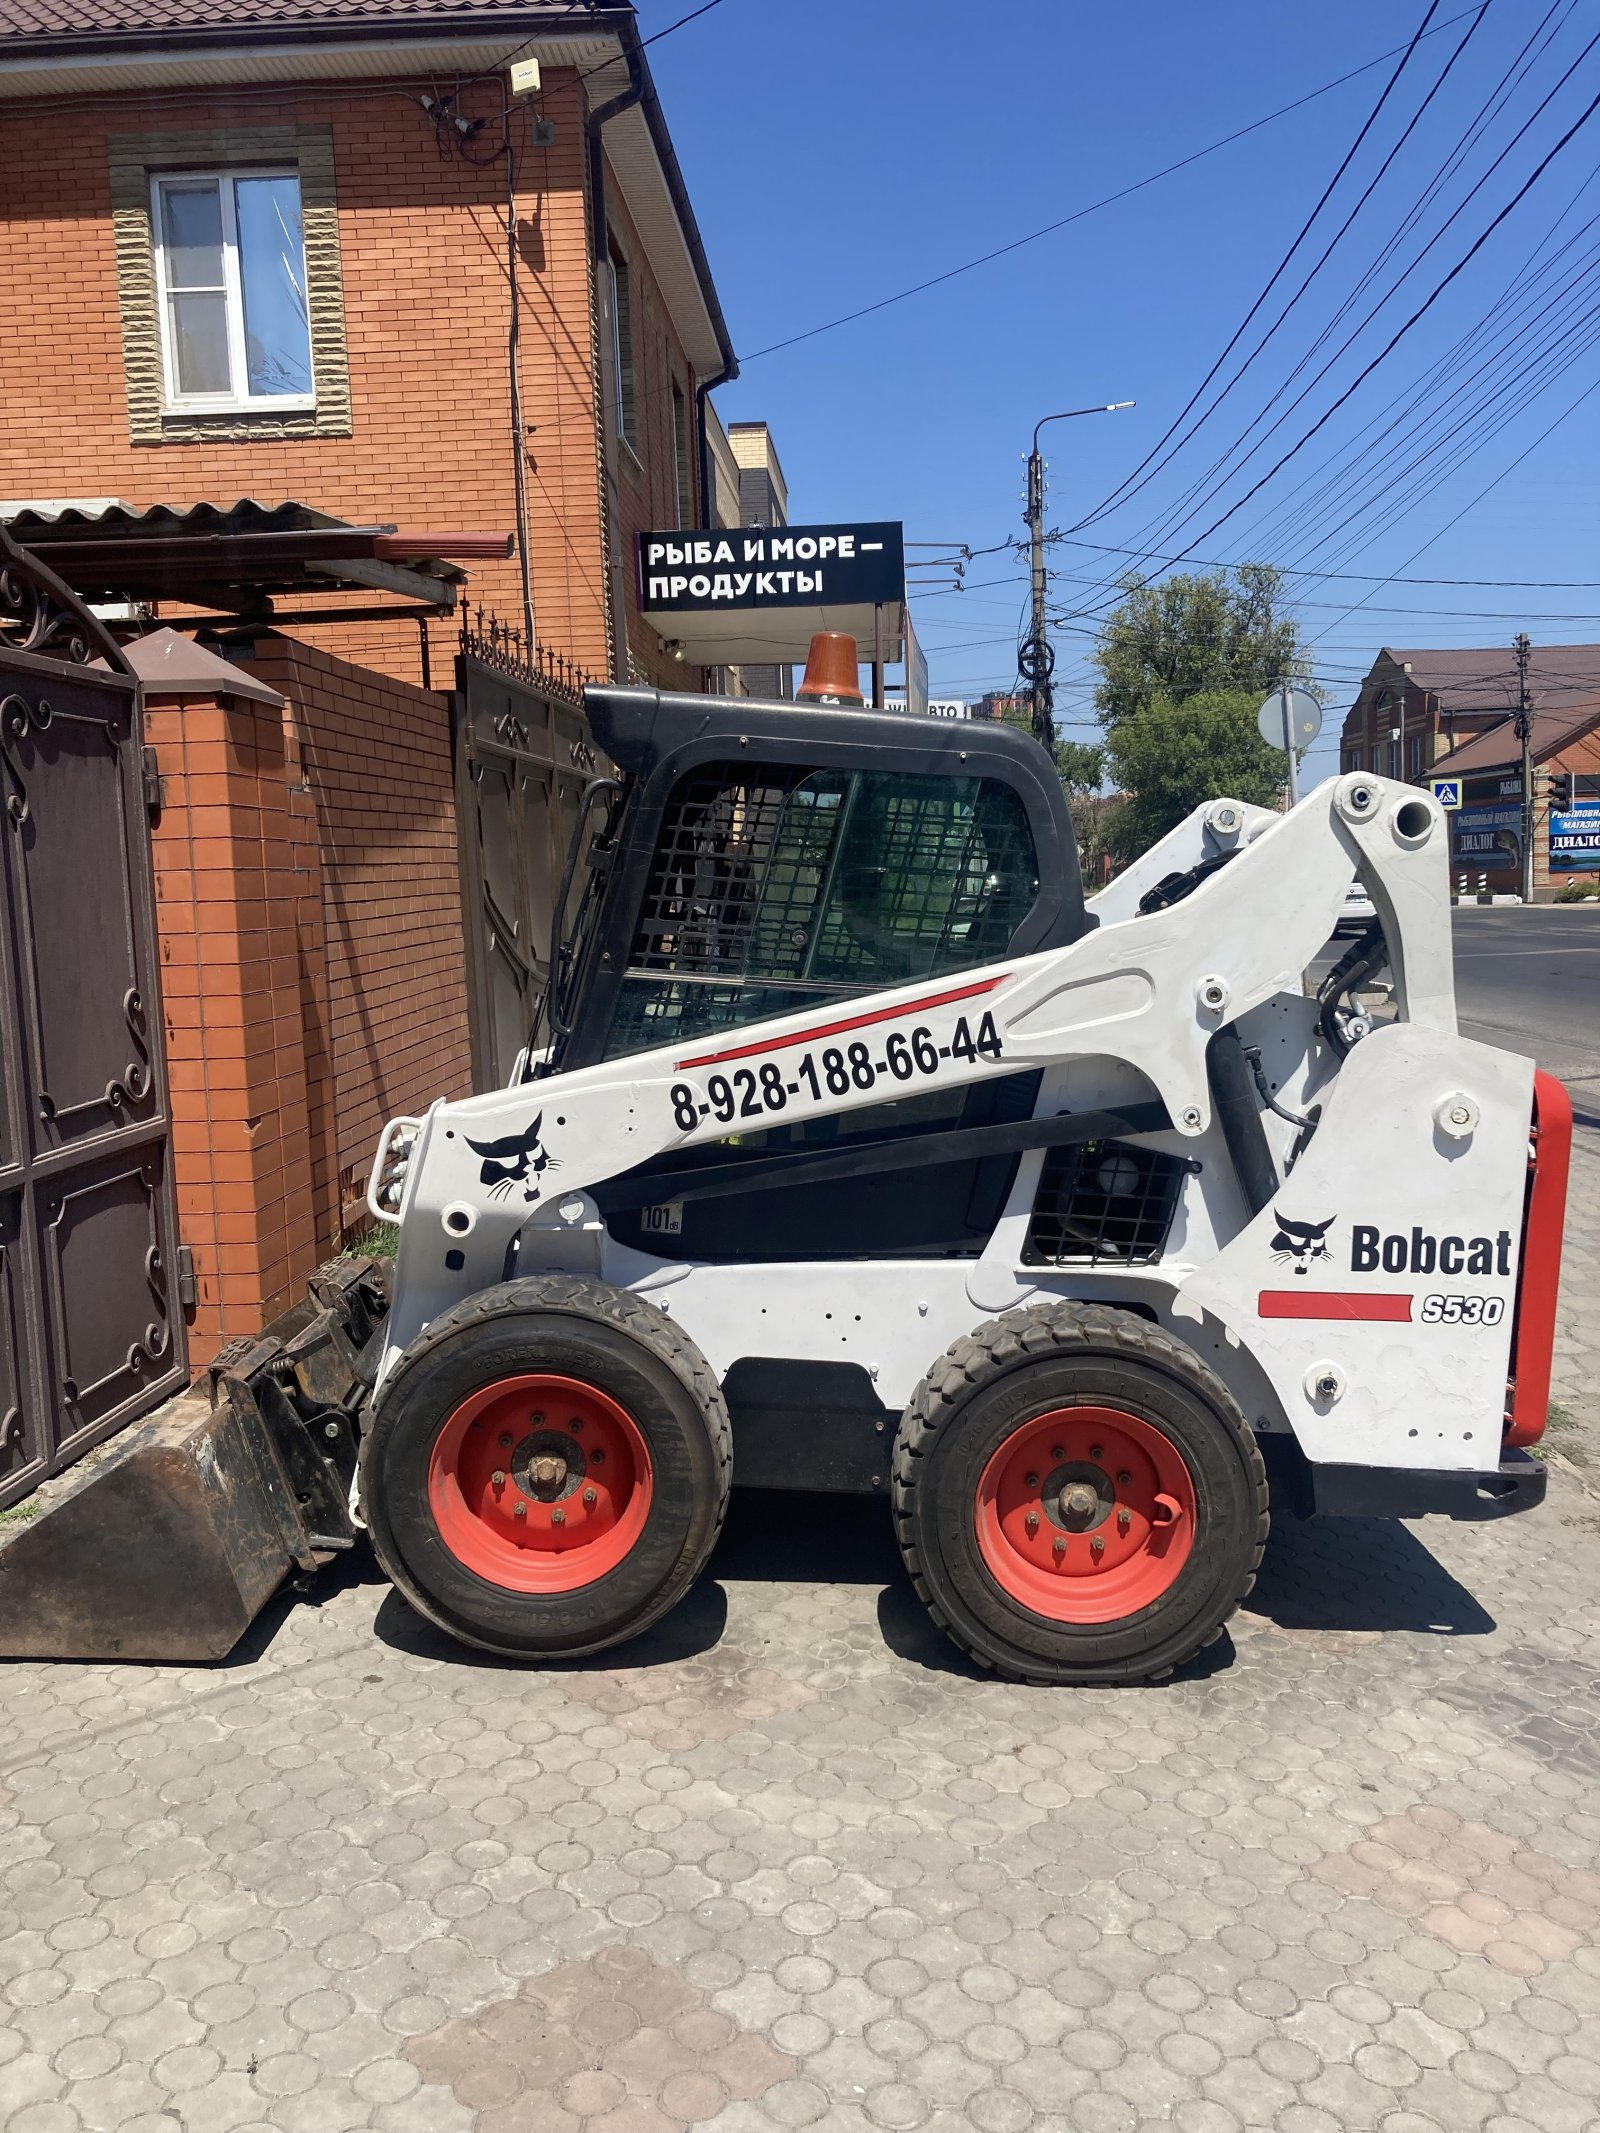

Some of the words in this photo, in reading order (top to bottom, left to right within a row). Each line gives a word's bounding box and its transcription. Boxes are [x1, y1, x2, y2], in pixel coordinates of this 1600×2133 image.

[648, 541, 735, 565] РЫБА
[744, 540, 765, 562] И
[771, 535, 855, 560] МОРЕ
[649, 570, 823, 600] ПРОДУКТЫ
[1551, 809, 1600, 819] РЫБОЛОВН
[1461, 833, 1495, 852] ДИАЛОГ
[670, 1010, 1003, 1132] 8-928-188-66-44
[1351, 1225, 1511, 1276] Bobcat
[1421, 1294, 1505, 1326] S530
